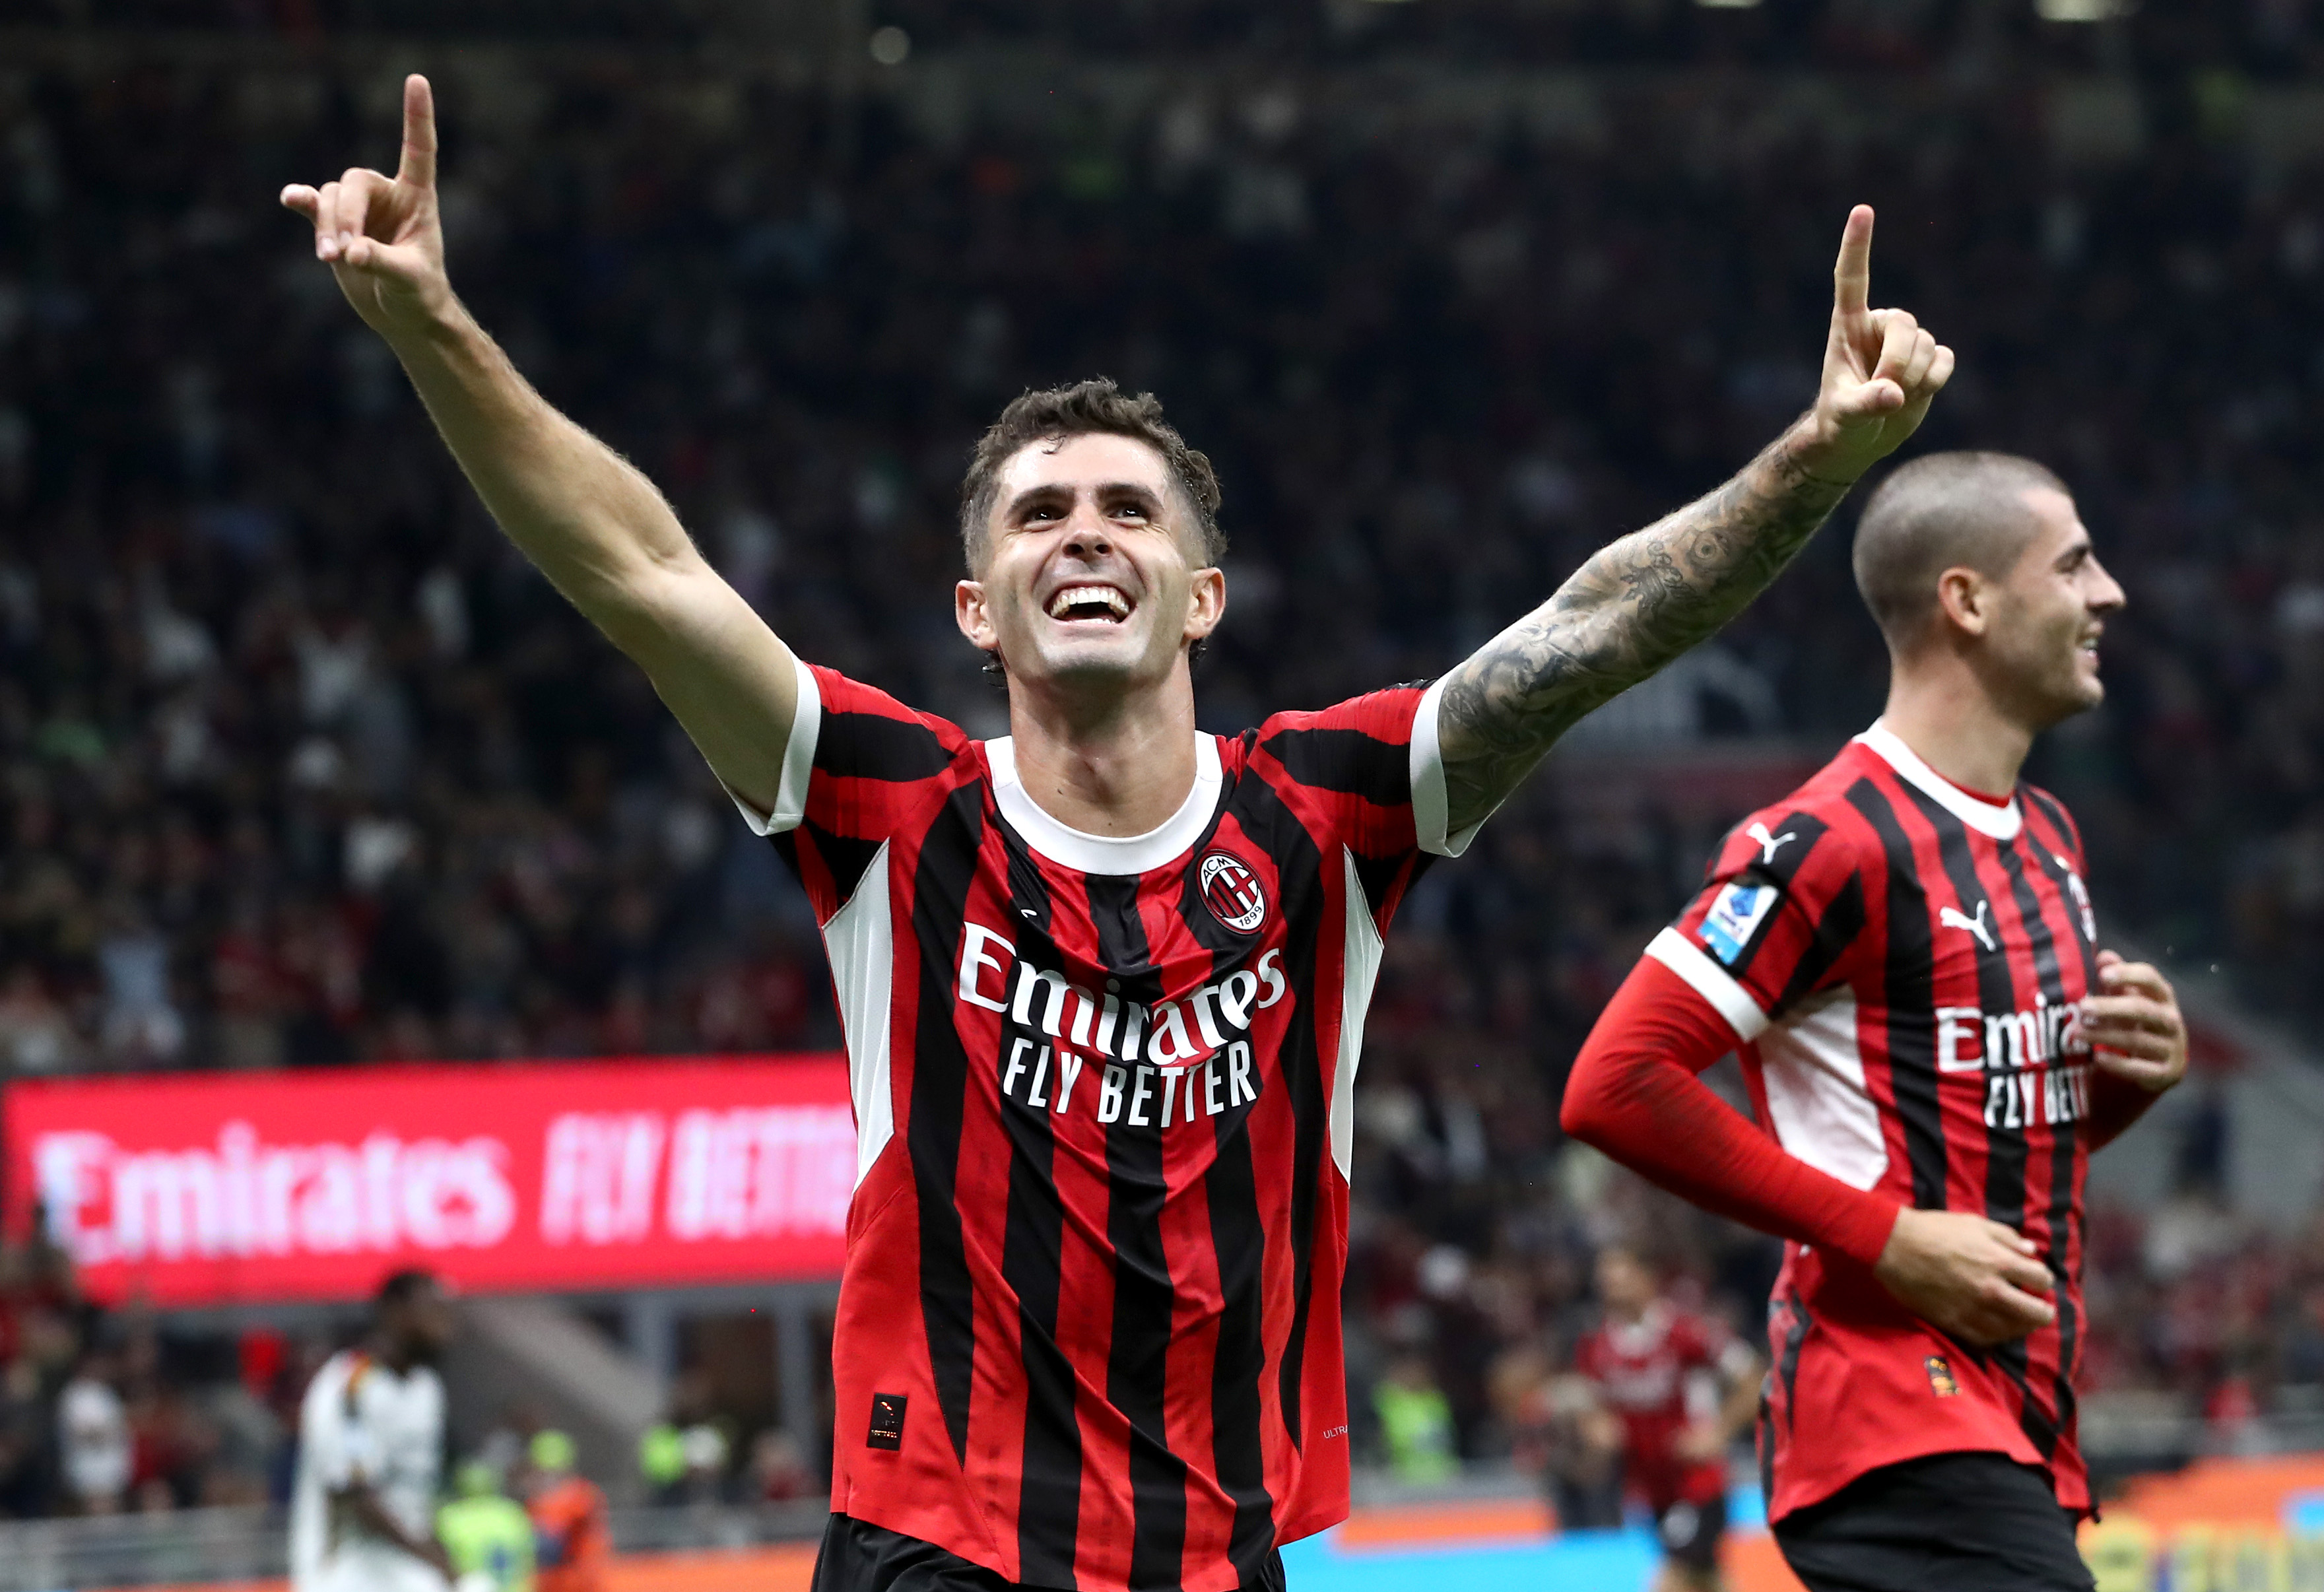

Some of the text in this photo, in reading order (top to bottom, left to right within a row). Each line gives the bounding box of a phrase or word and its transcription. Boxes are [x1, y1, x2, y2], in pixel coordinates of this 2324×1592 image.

[1203, 858, 1232, 884] ACM
[1238, 906, 1262, 927] 1899
[958, 921, 1286, 1065] Emirates
[1935, 991, 2089, 1073] Emira
[1003, 1037, 1257, 1128] FLY BETTER
[1984, 1065, 2090, 1129] FLY BETT
[34, 1120, 515, 1263] Emirates
[668, 1104, 857, 1238] BETTE
